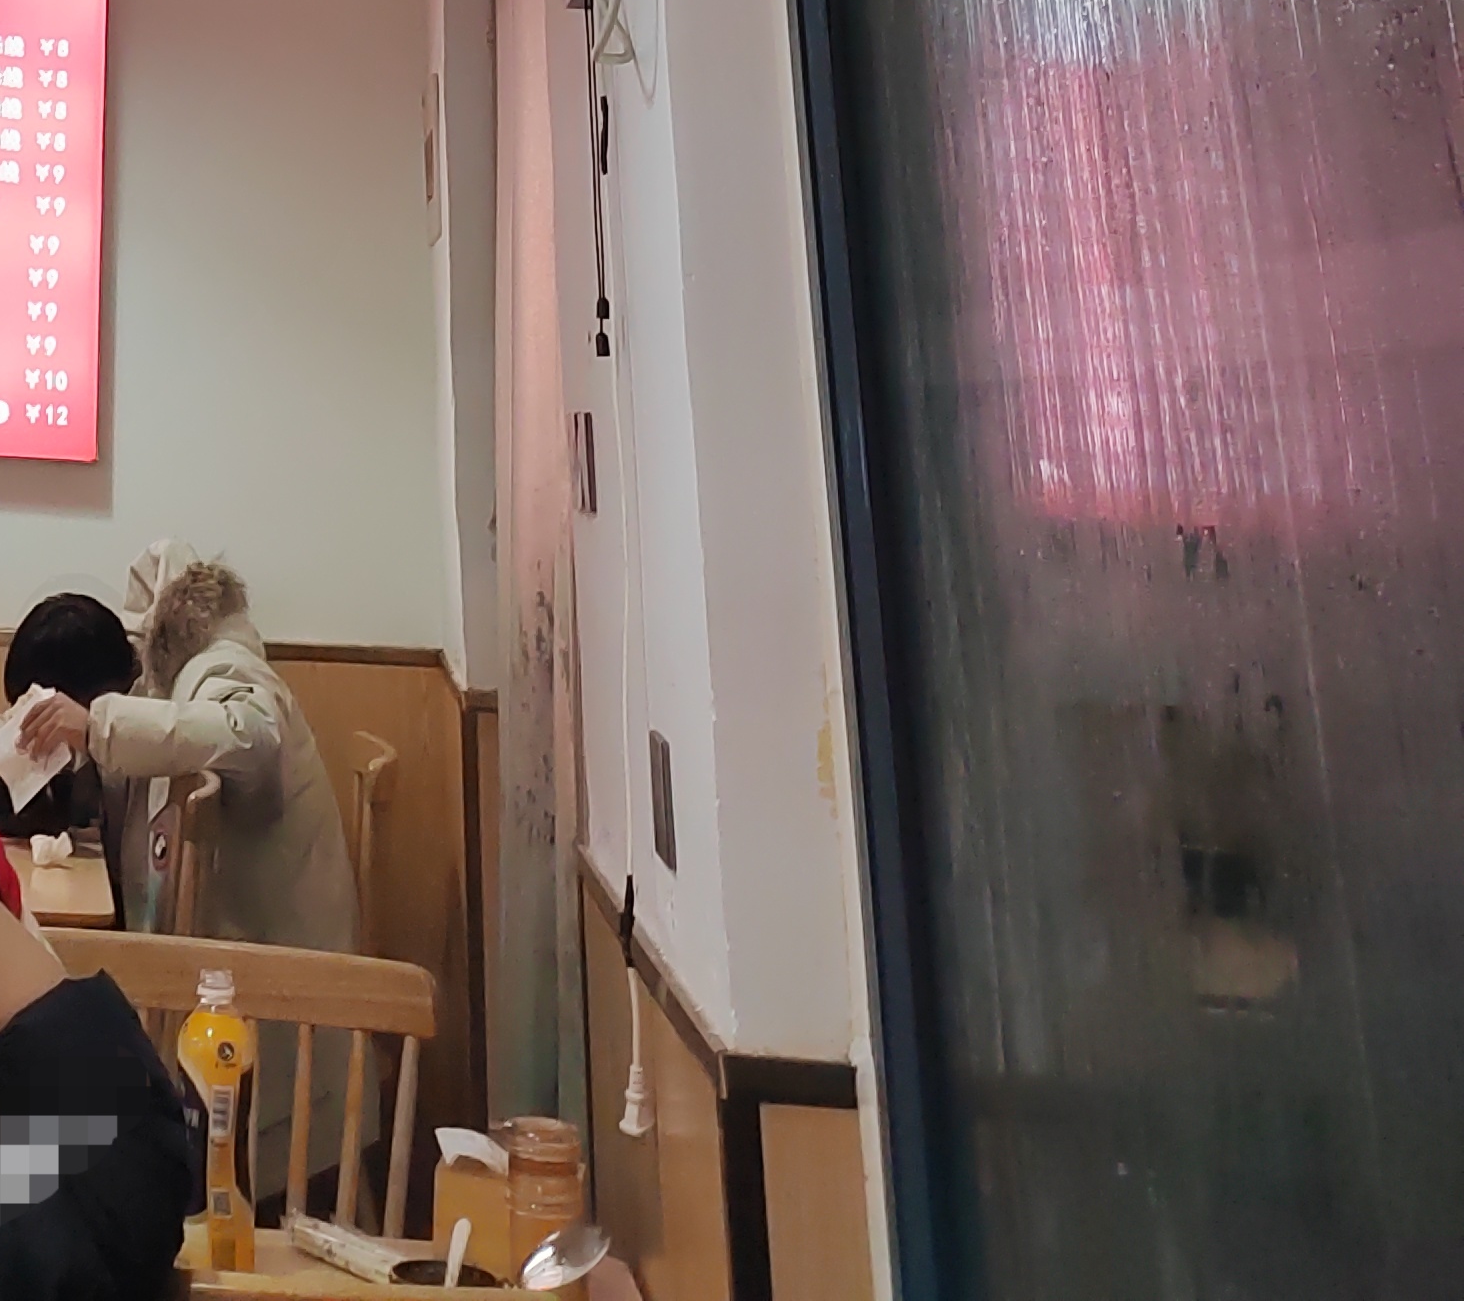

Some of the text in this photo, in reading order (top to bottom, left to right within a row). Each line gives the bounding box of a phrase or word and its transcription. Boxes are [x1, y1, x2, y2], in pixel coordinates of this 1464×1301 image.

[40, 38, 69, 58] ¥8
[38, 69, 68, 89] ¥8
[36, 132, 66, 152] ¥8
[35, 164, 65, 185] ¥9
[36, 196, 66, 217] ¥9
[29, 234, 60, 256] ¥9
[28, 268, 59, 289] ¥9
[27, 301, 58, 322] ¥9
[26, 335, 57, 356] ¥9
[25, 368, 68, 391] ¥10
[25, 404, 68, 426] ¥12
